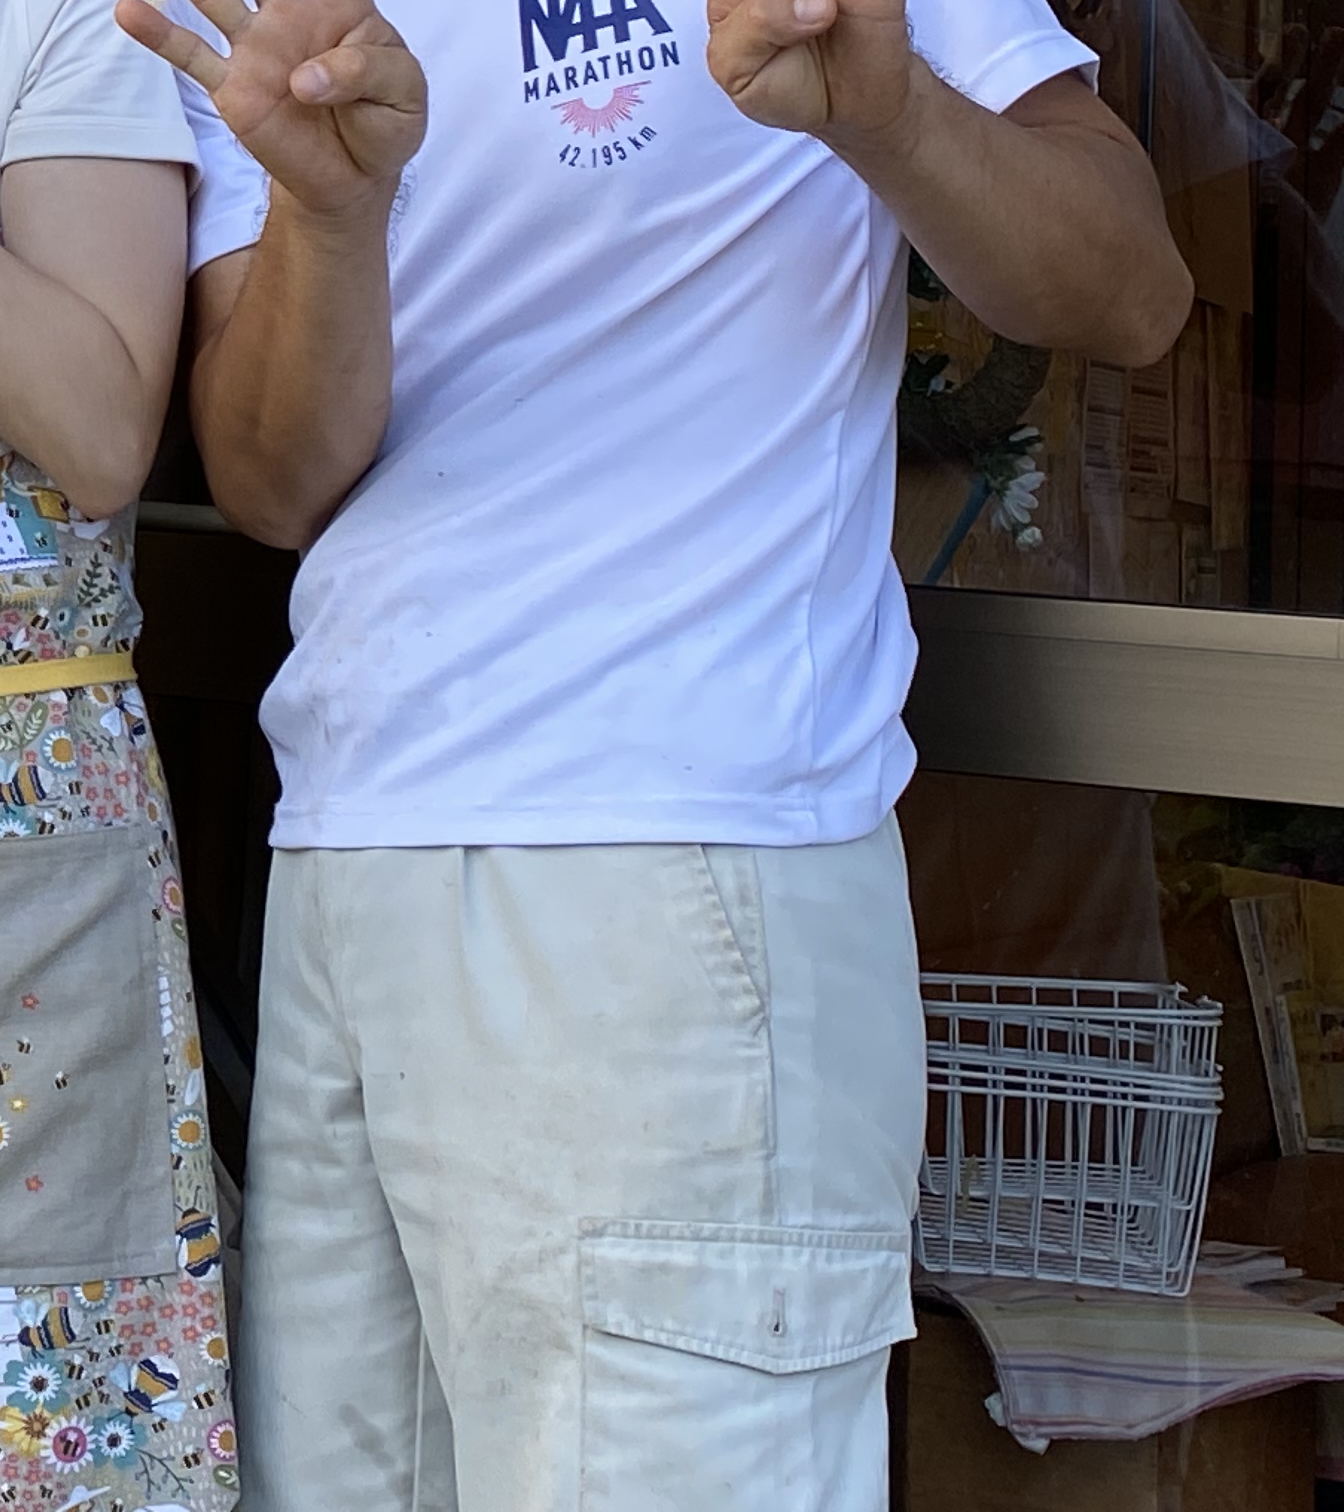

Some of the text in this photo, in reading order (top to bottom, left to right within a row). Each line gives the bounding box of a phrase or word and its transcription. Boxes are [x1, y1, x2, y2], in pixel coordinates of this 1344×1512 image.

[524, 41, 680, 103] MARATHON
[559, 125, 658, 169] 42.195 km
